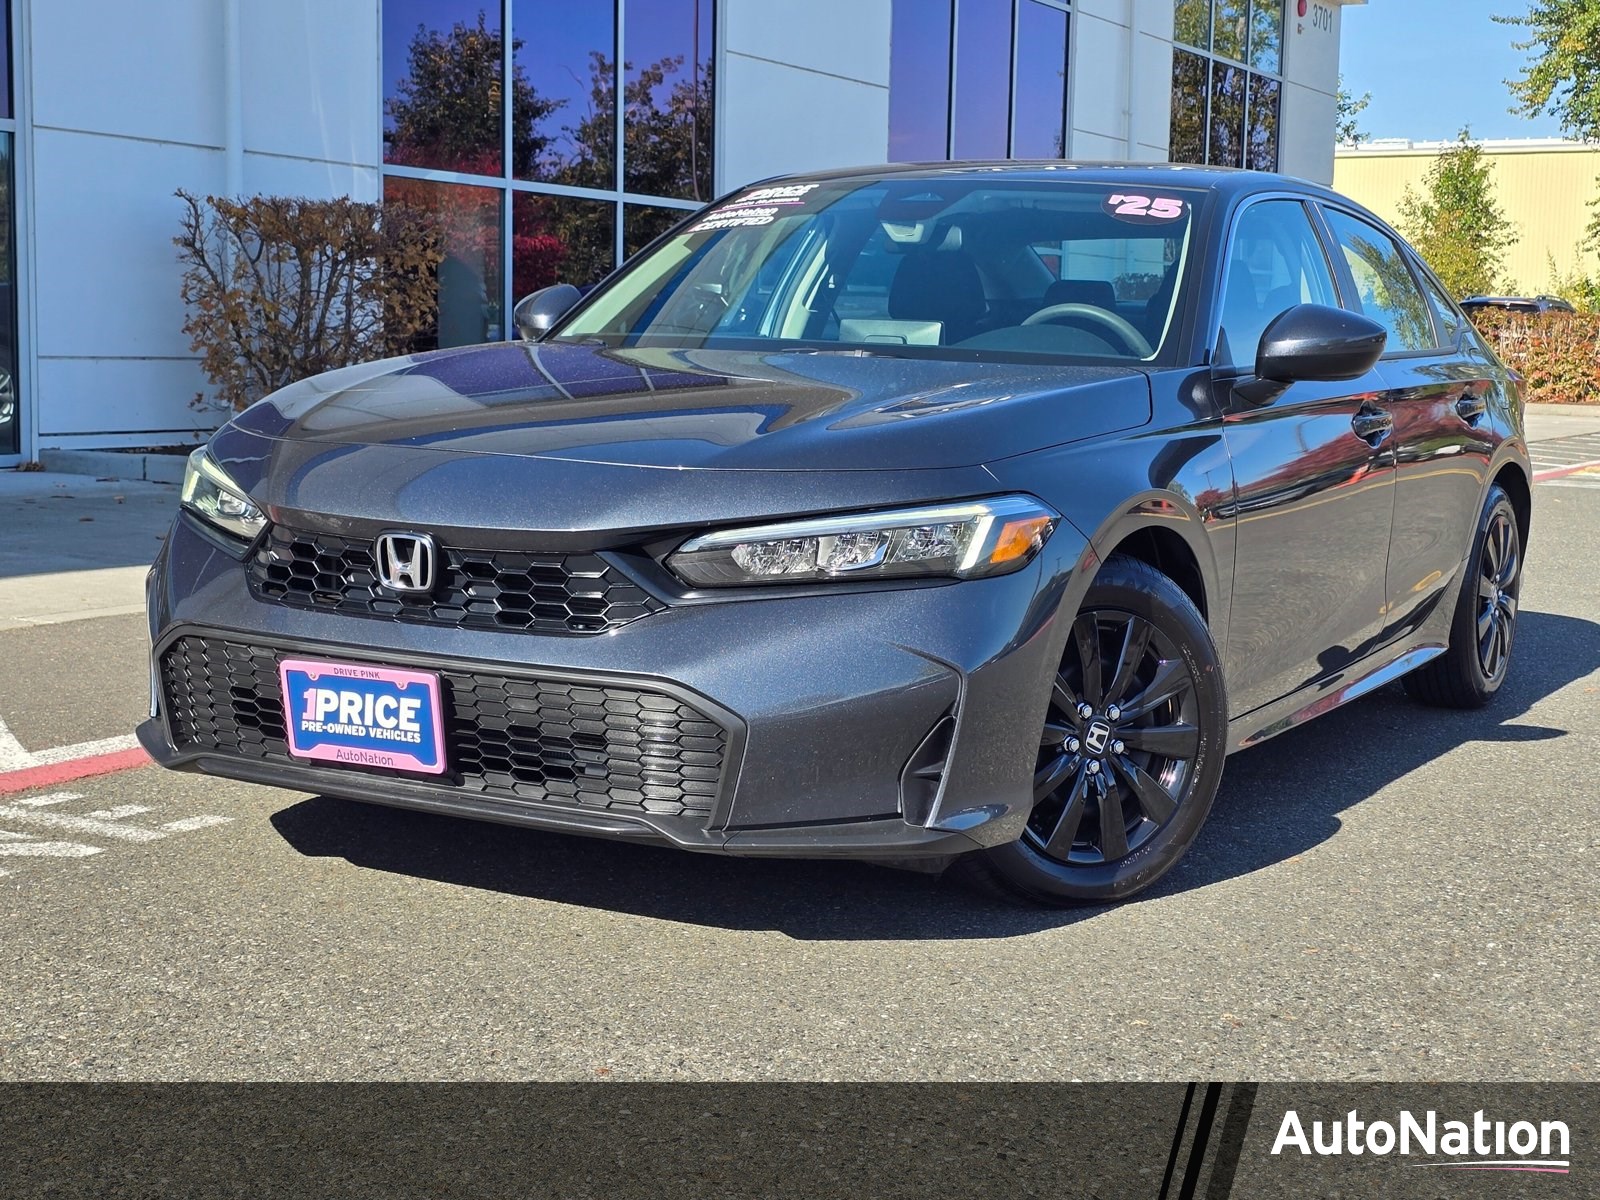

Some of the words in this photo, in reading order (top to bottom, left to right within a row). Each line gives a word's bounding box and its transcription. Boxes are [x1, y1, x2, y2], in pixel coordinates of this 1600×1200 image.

[1312, 3, 1333, 33] 3701
[333, 667, 358, 677] DRIVE
[360, 670, 381, 679] PINK
[301, 720, 366, 737] PRE-OWNED
[368, 727, 421, 744] VEHICLES
[336, 749, 394, 766] AutoNation
